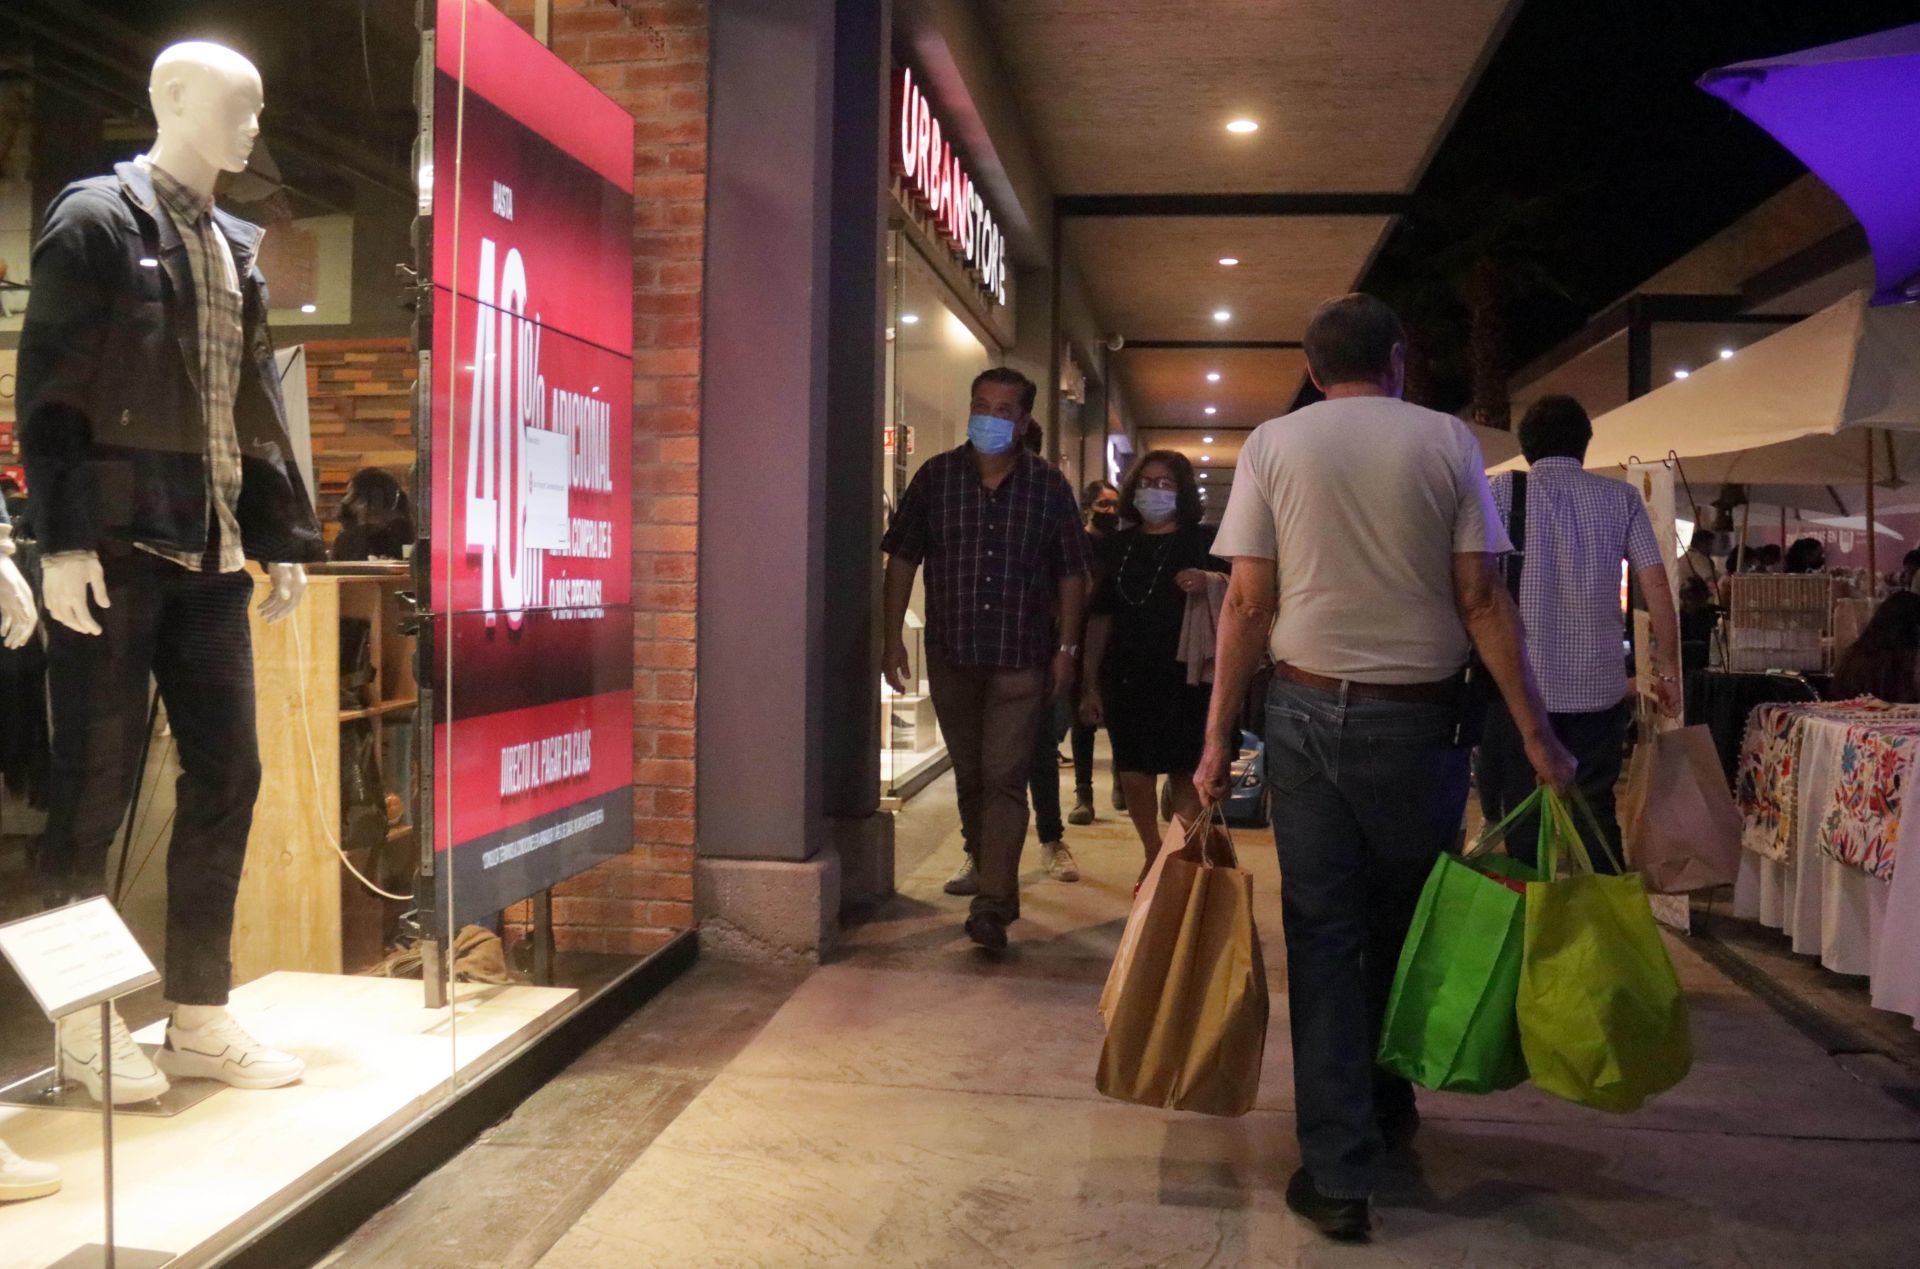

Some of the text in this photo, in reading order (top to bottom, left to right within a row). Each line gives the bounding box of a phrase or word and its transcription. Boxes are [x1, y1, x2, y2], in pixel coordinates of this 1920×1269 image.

[901, 67, 1006, 306] URBANSTORE
[572, 517, 598, 557] COMPRA
[501, 742, 531, 795] DIRECTO
[531, 741, 540, 787] AL
[563, 733, 572, 778] EN
